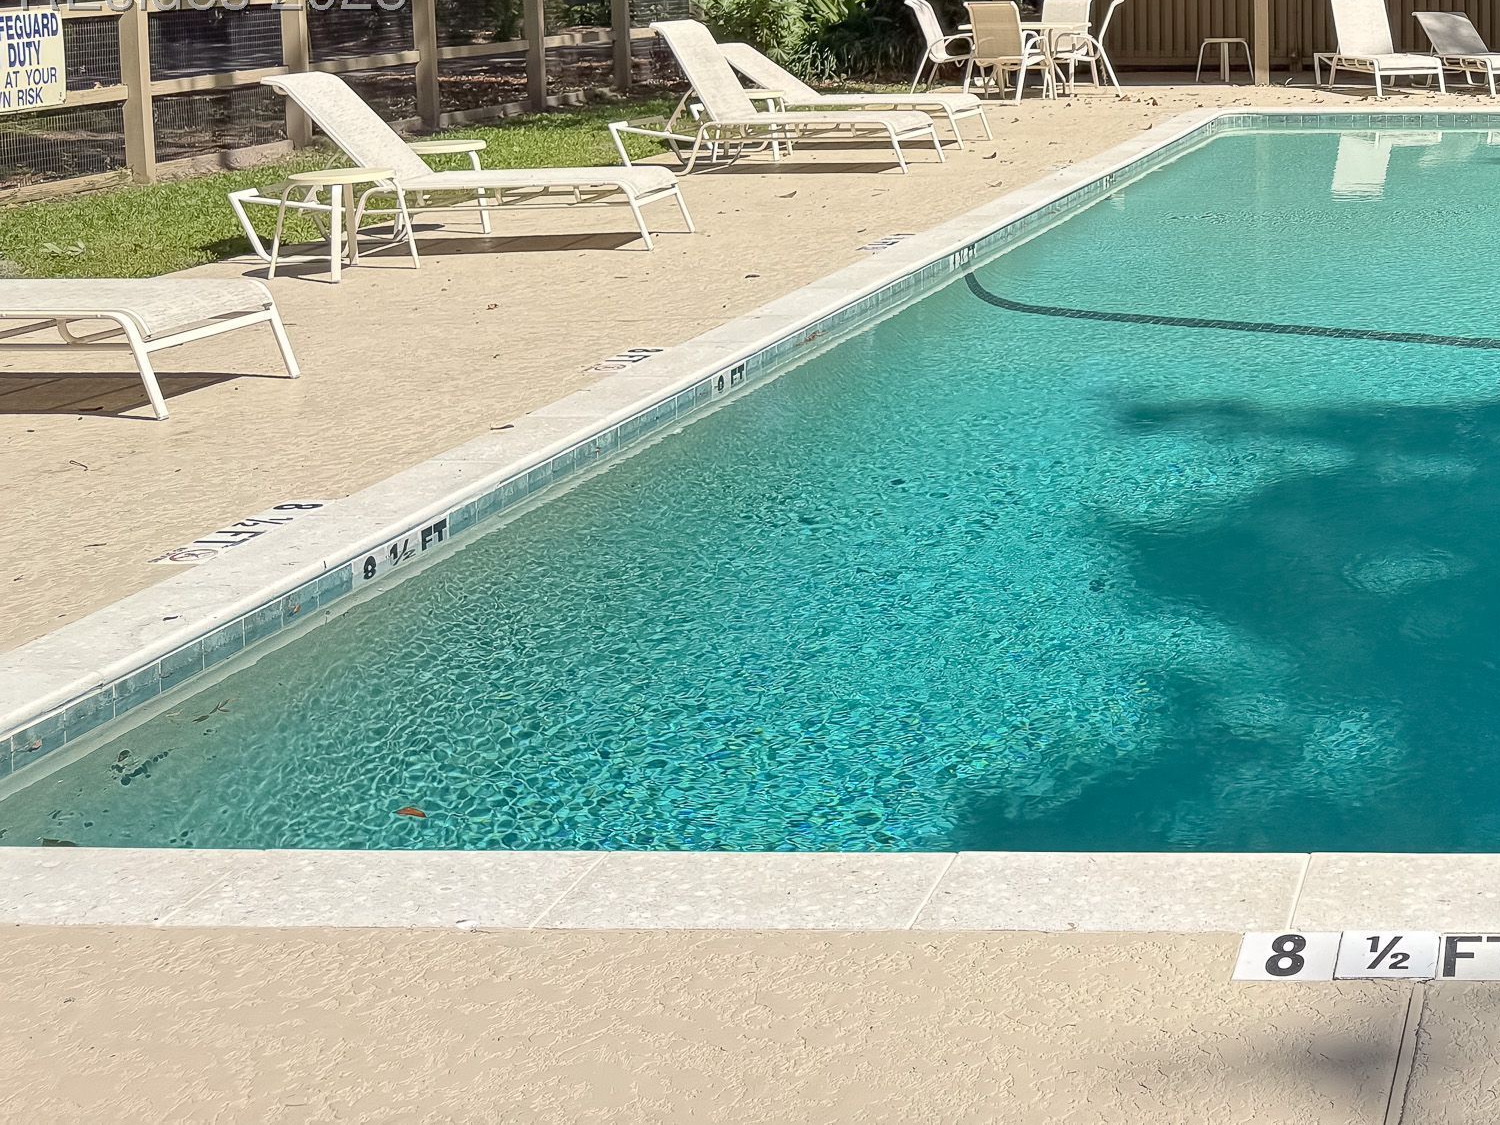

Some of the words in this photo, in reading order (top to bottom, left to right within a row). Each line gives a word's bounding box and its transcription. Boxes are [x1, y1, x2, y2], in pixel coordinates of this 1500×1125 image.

[8, 40, 41, 68] DUTY
[5, 71, 20, 89] AT
[26, 67, 57, 86] YOUR
[0, 91, 11, 108] N
[18, 87, 43, 106] RISK
[421, 518, 447, 551] FT
[1264, 934, 1307, 977] 8
